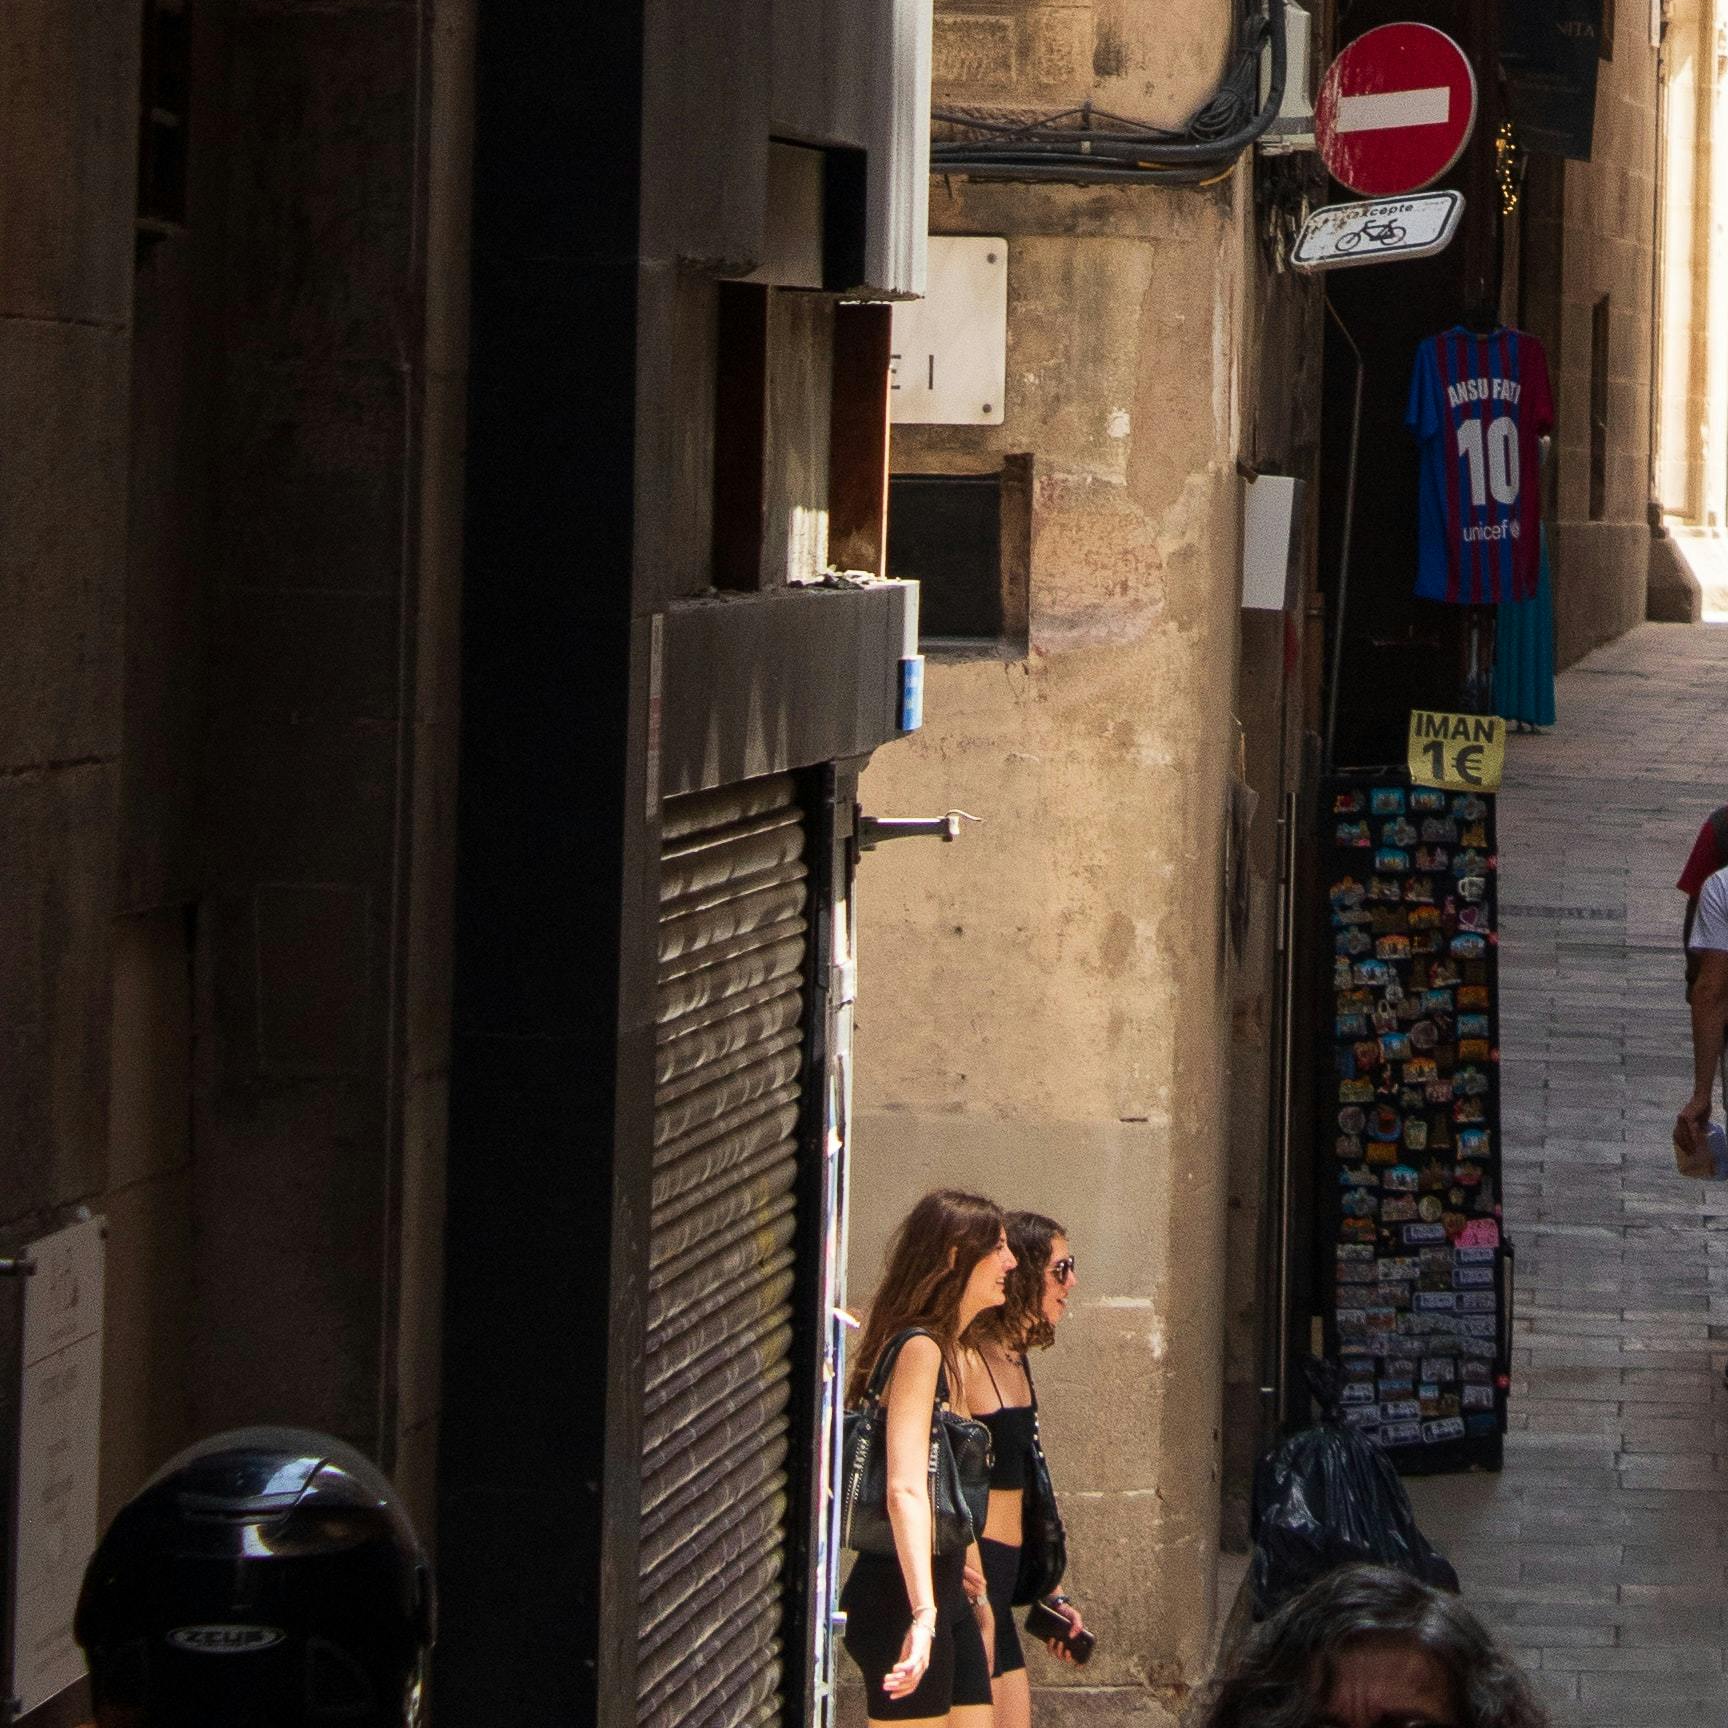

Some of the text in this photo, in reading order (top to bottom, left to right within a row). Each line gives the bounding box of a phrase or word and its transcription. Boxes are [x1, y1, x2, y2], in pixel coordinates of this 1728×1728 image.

[1447, 378, 1521, 408] ANSU FATI
[1456, 416, 1520, 506] 10
[1463, 519, 1508, 542] unicef
[1414, 712, 1495, 744] IMAN
